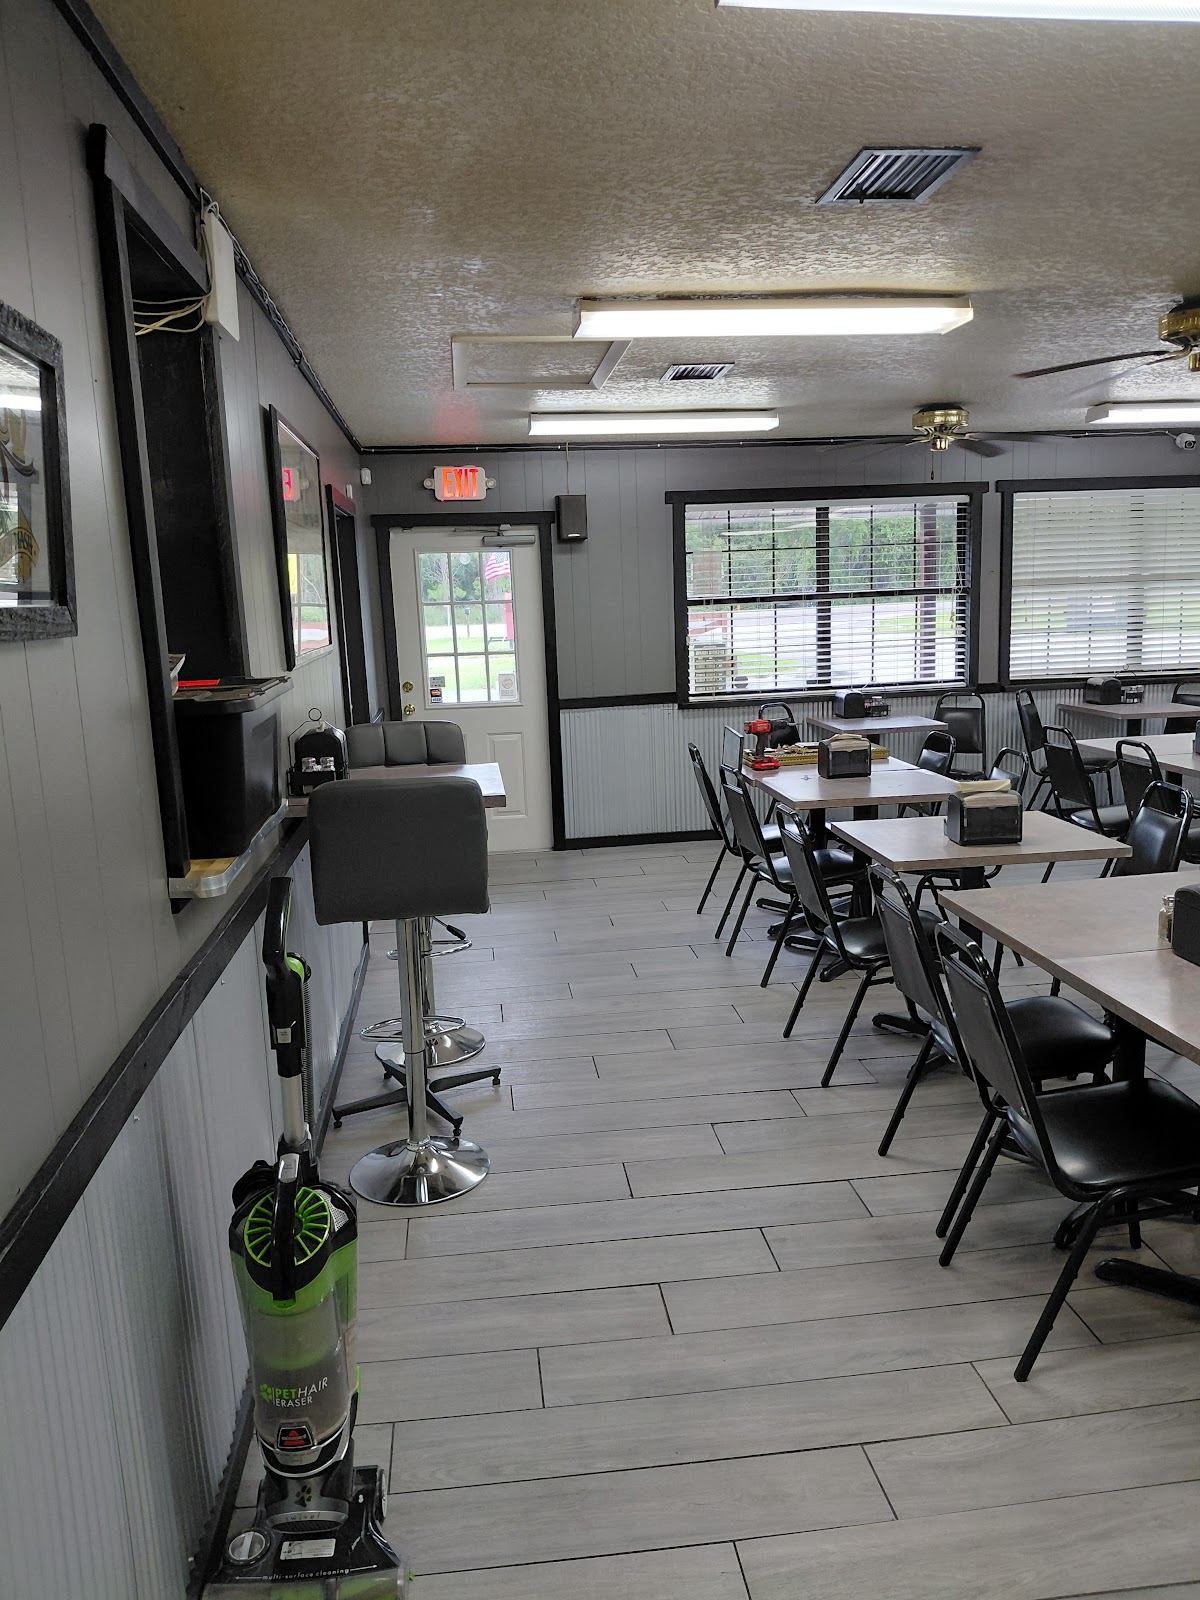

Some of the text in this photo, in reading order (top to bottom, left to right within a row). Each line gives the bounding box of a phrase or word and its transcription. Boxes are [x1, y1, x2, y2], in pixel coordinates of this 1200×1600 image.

[442, 468, 479, 498] EXIT
[275, 1396, 313, 1408] ERASER
[315, 1568, 350, 1578] cleaning
